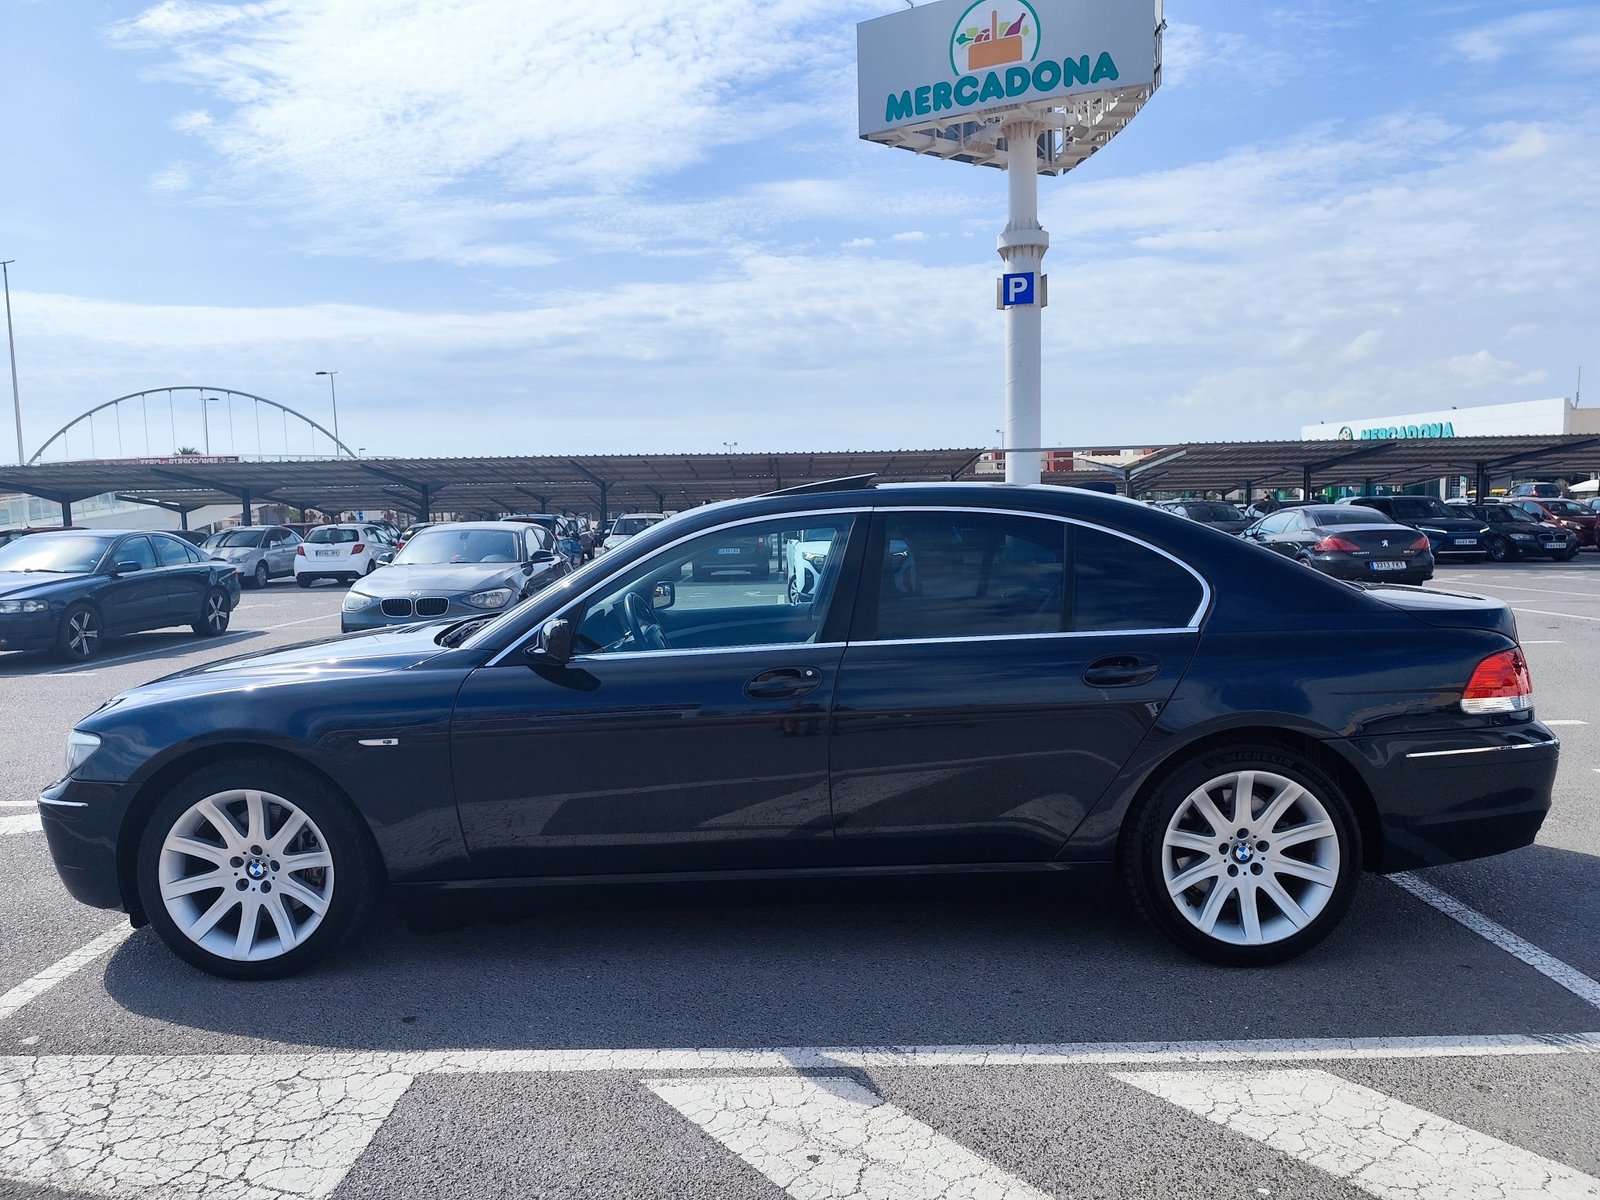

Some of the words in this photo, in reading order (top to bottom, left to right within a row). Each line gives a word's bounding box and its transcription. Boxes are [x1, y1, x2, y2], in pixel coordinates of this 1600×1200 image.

[885, 51, 1119, 123] MERCADONA
[1009, 277, 1028, 302] P
[1361, 422, 1455, 440] MERCADONA
[1224, 752, 1293, 767] MICHELIN
